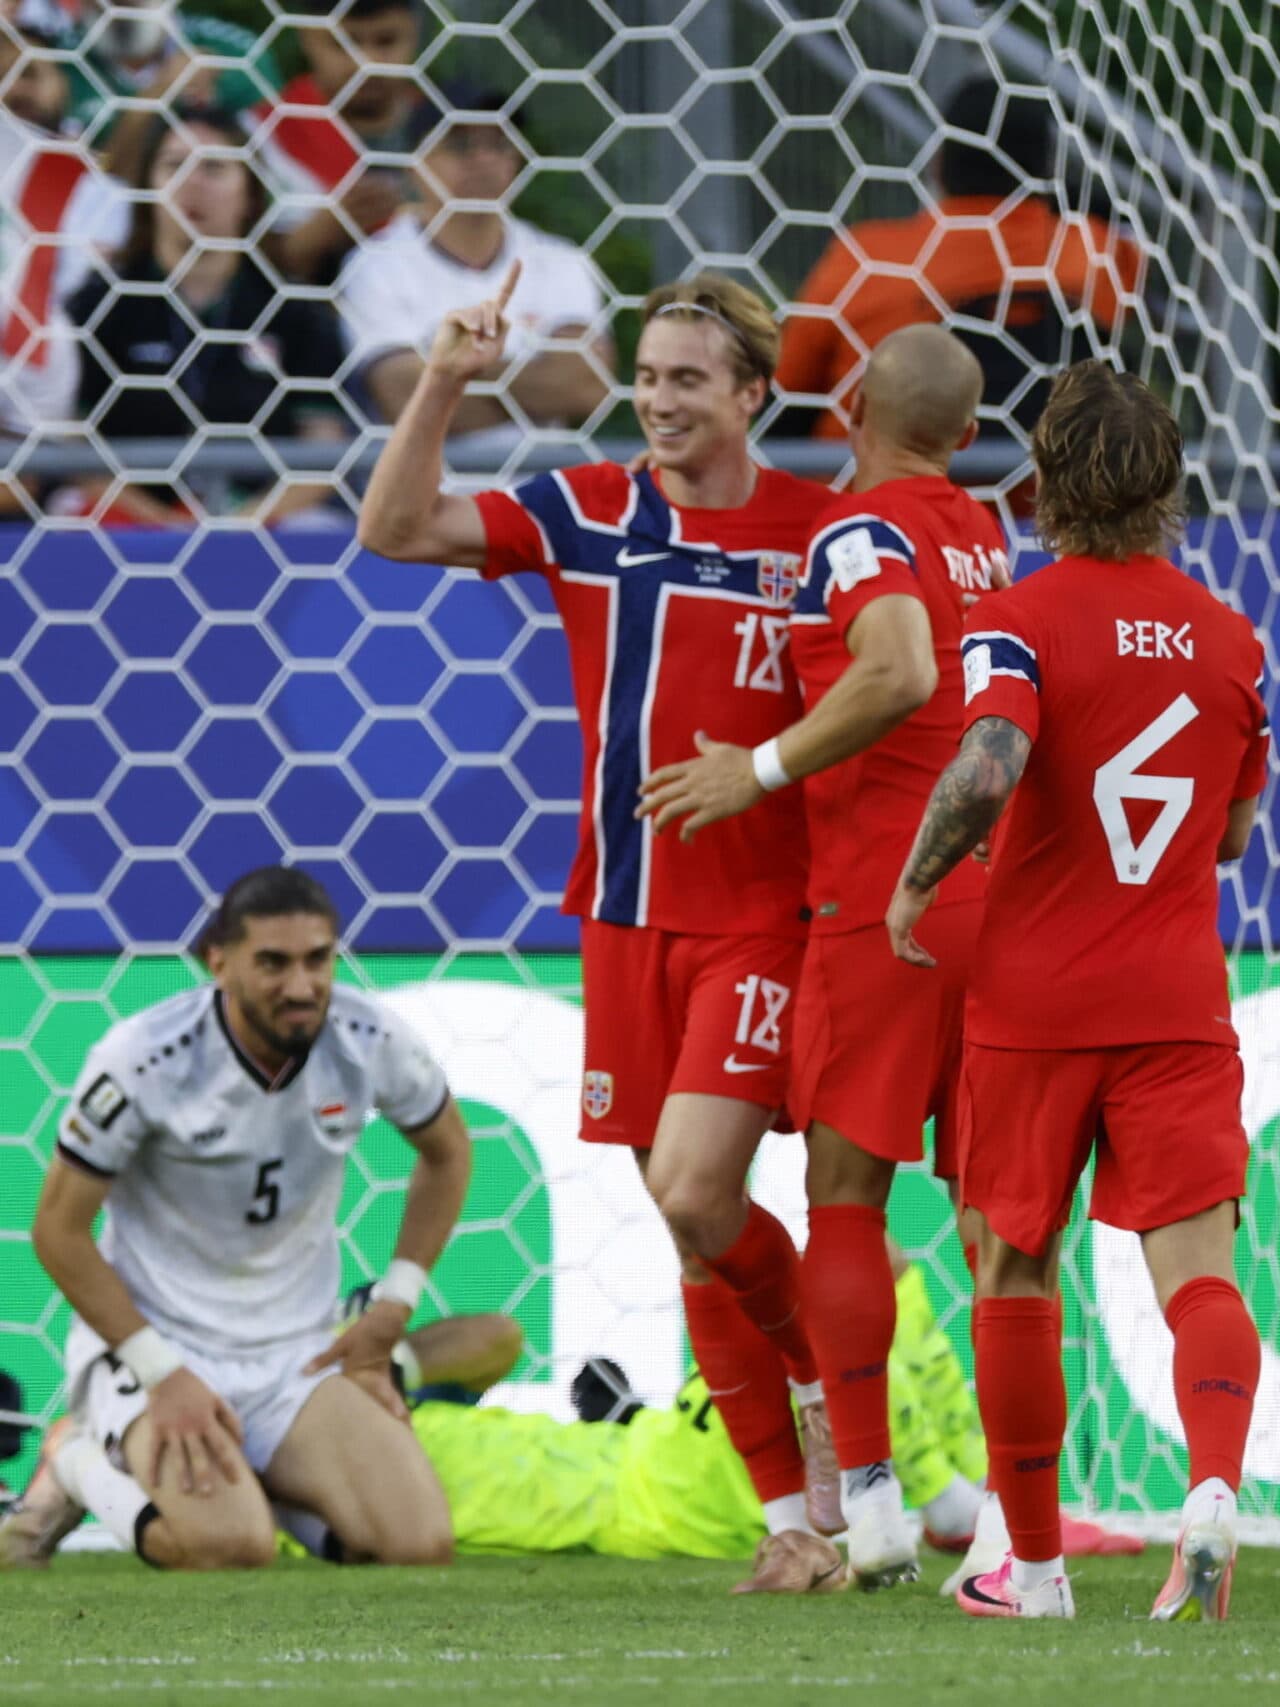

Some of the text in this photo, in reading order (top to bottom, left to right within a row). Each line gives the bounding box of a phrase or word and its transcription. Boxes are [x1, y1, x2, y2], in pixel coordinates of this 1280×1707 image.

[733, 612, 792, 694] 18
[1115, 618, 1195, 661] BERG
[1092, 691, 1200, 886] 6
[735, 973, 791, 1055] 18
[246, 1158, 284, 1226] 5
